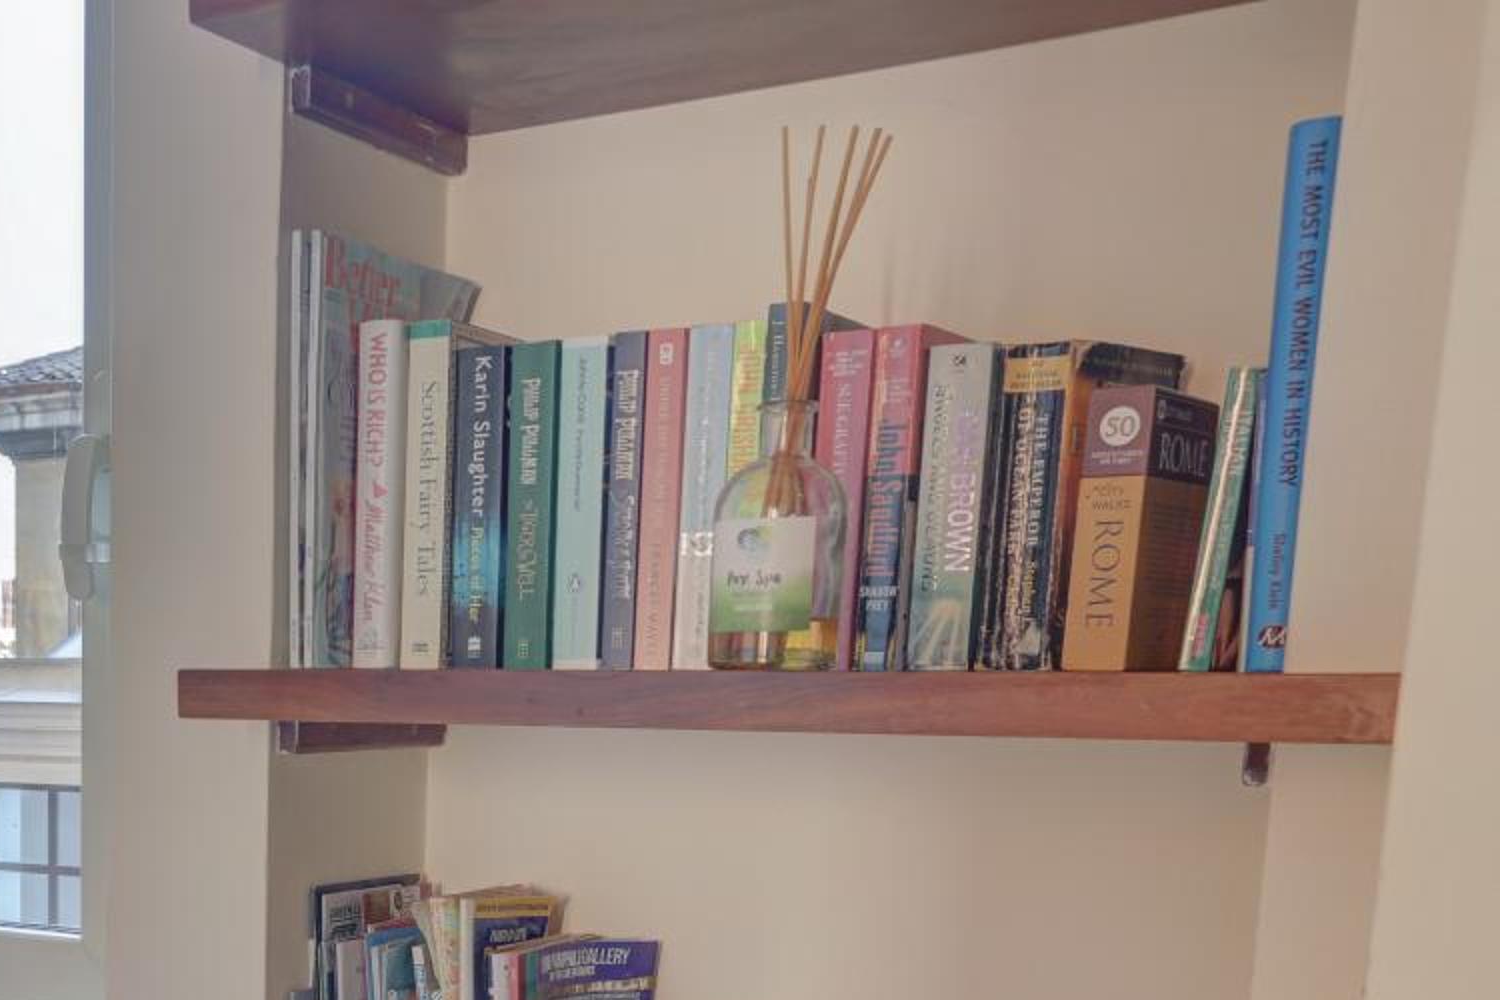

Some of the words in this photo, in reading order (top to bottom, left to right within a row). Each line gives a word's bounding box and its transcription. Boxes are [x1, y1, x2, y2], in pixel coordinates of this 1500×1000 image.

[1306, 139, 1328, 176] THE
[1300, 186, 1324, 240] MOST
[1295, 250, 1317, 289] EVIL
[366, 333, 388, 385] WHO
[1288, 297, 1313, 371] WOMEN
[368, 389, 387, 404] IS
[474, 355, 493, 413] Karin
[1286, 381, 1304, 400] IN
[365, 409, 387, 468] RICH?
[419, 380, 440, 469] Scottish
[878, 422, 907, 475] John
[1034, 413, 1050, 450] THE
[1105, 415, 1136, 437] 50
[1278, 408, 1303, 488] HISTORY
[467, 420, 492, 518] Slaughter
[1158, 431, 1210, 478] ROME
[411, 478, 438, 533] Fairy
[944, 473, 975, 572] BROWN
[1027, 458, 1047, 546] EMPEROR
[416, 545, 438, 596] Tales
[1084, 518, 1125, 628] ROME
